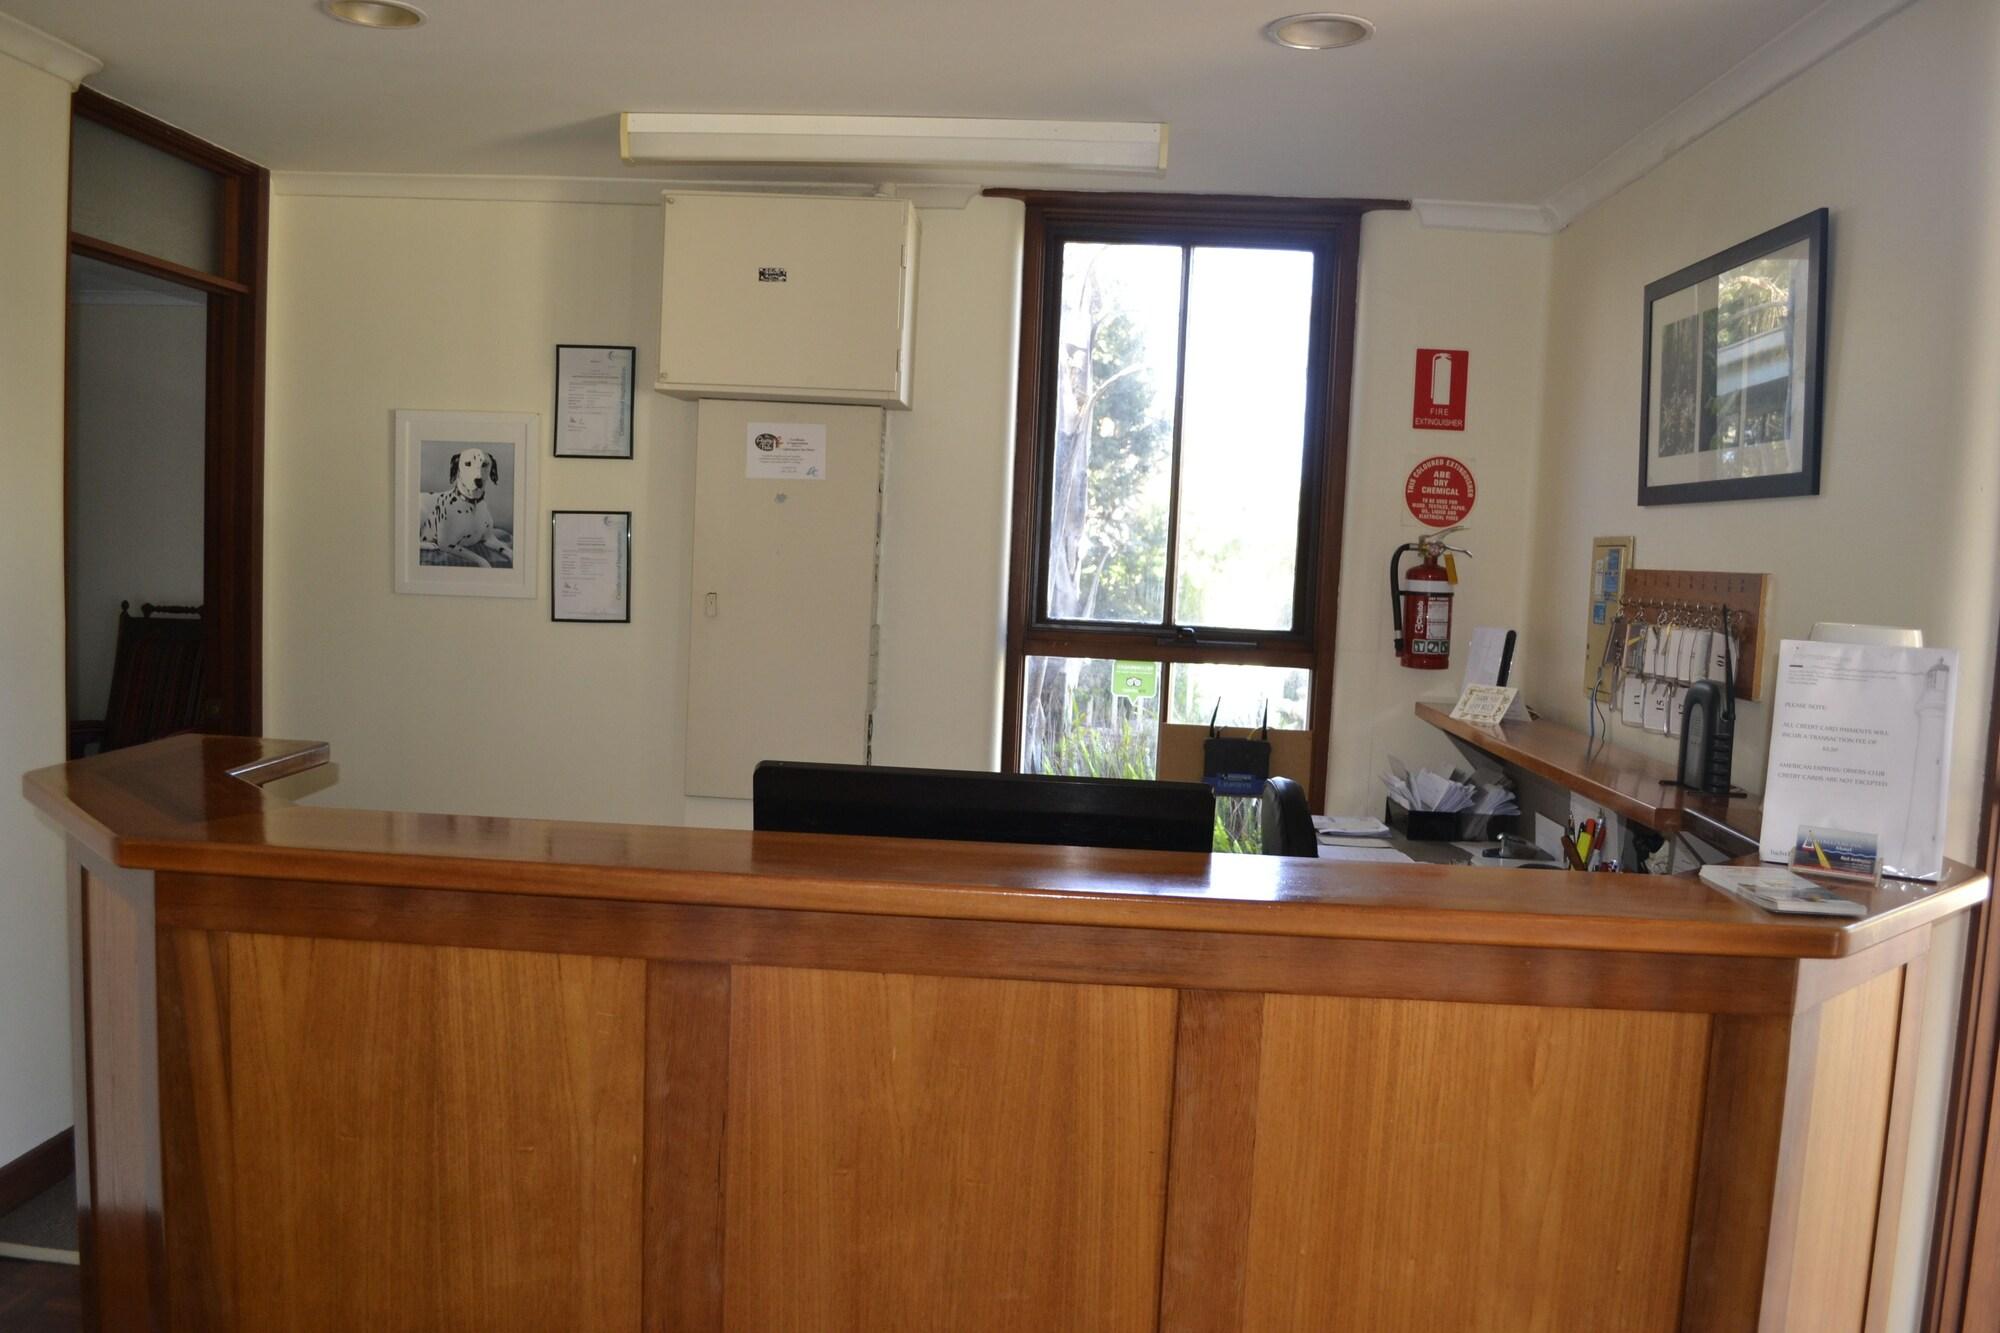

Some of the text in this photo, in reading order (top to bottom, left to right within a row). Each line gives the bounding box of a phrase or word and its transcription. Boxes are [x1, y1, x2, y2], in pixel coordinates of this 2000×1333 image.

[1430, 407, 1449, 416] FIRE
[1415, 417, 1464, 427] EXTINGUISHER
[1413, 459, 1445, 478] COLOURED
[1433, 470, 1451, 479] ARE
[1433, 479, 1449, 487] DRY
[1421, 486, 1460, 496] CHEMICAL
[1655, 699, 1665, 712] 15
[1784, 701, 1806, 710] PLEASE
[1795, 723, 1818, 731] CREDIT
[1839, 727, 1872, 735] PAYMENTS
[1782, 731, 1801, 739] INCUR
[1809, 734, 1854, 744] TRANSACTION
[1779, 762, 1812, 771] AMERICAN
[1867, 769, 1886, 777] CLUB
